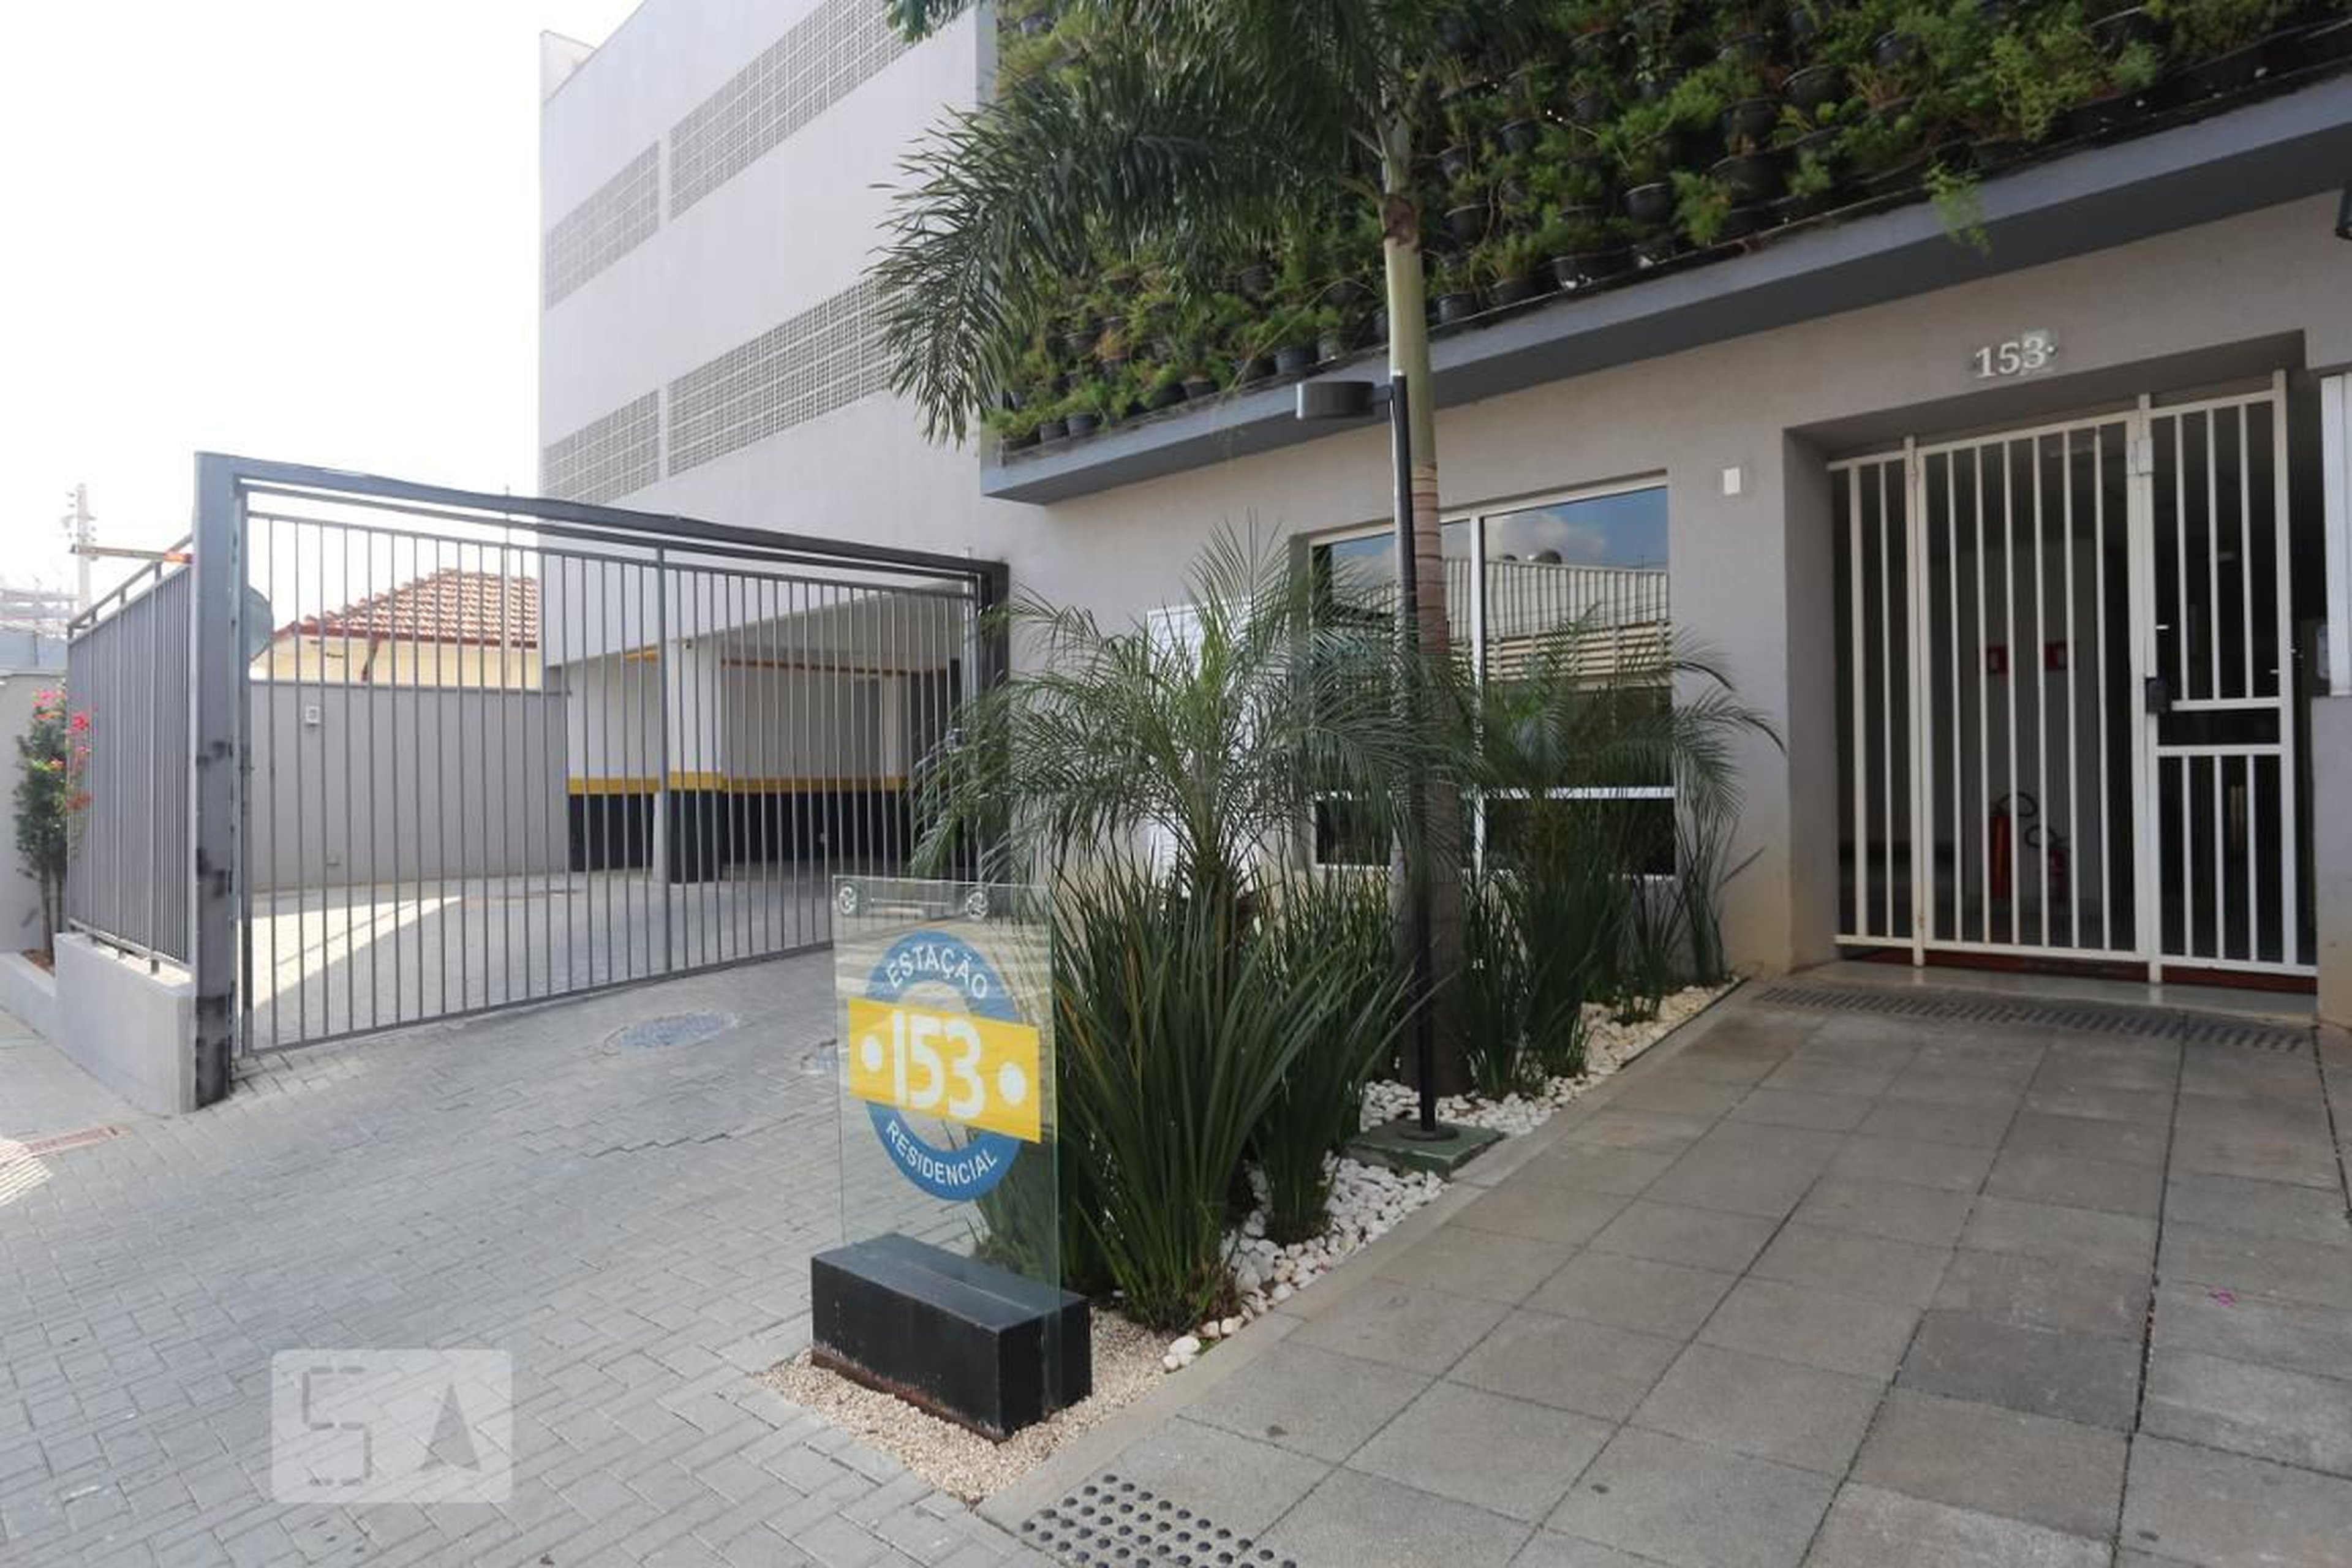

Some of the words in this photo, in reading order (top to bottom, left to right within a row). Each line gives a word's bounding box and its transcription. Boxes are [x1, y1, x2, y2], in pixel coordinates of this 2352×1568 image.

[1976, 337, 2046, 379] 153
[886, 944, 987, 999] ESTAÇÃO
[892, 1010, 986, 1118] 153
[886, 1120, 997, 1186] RESIDENCIAL
